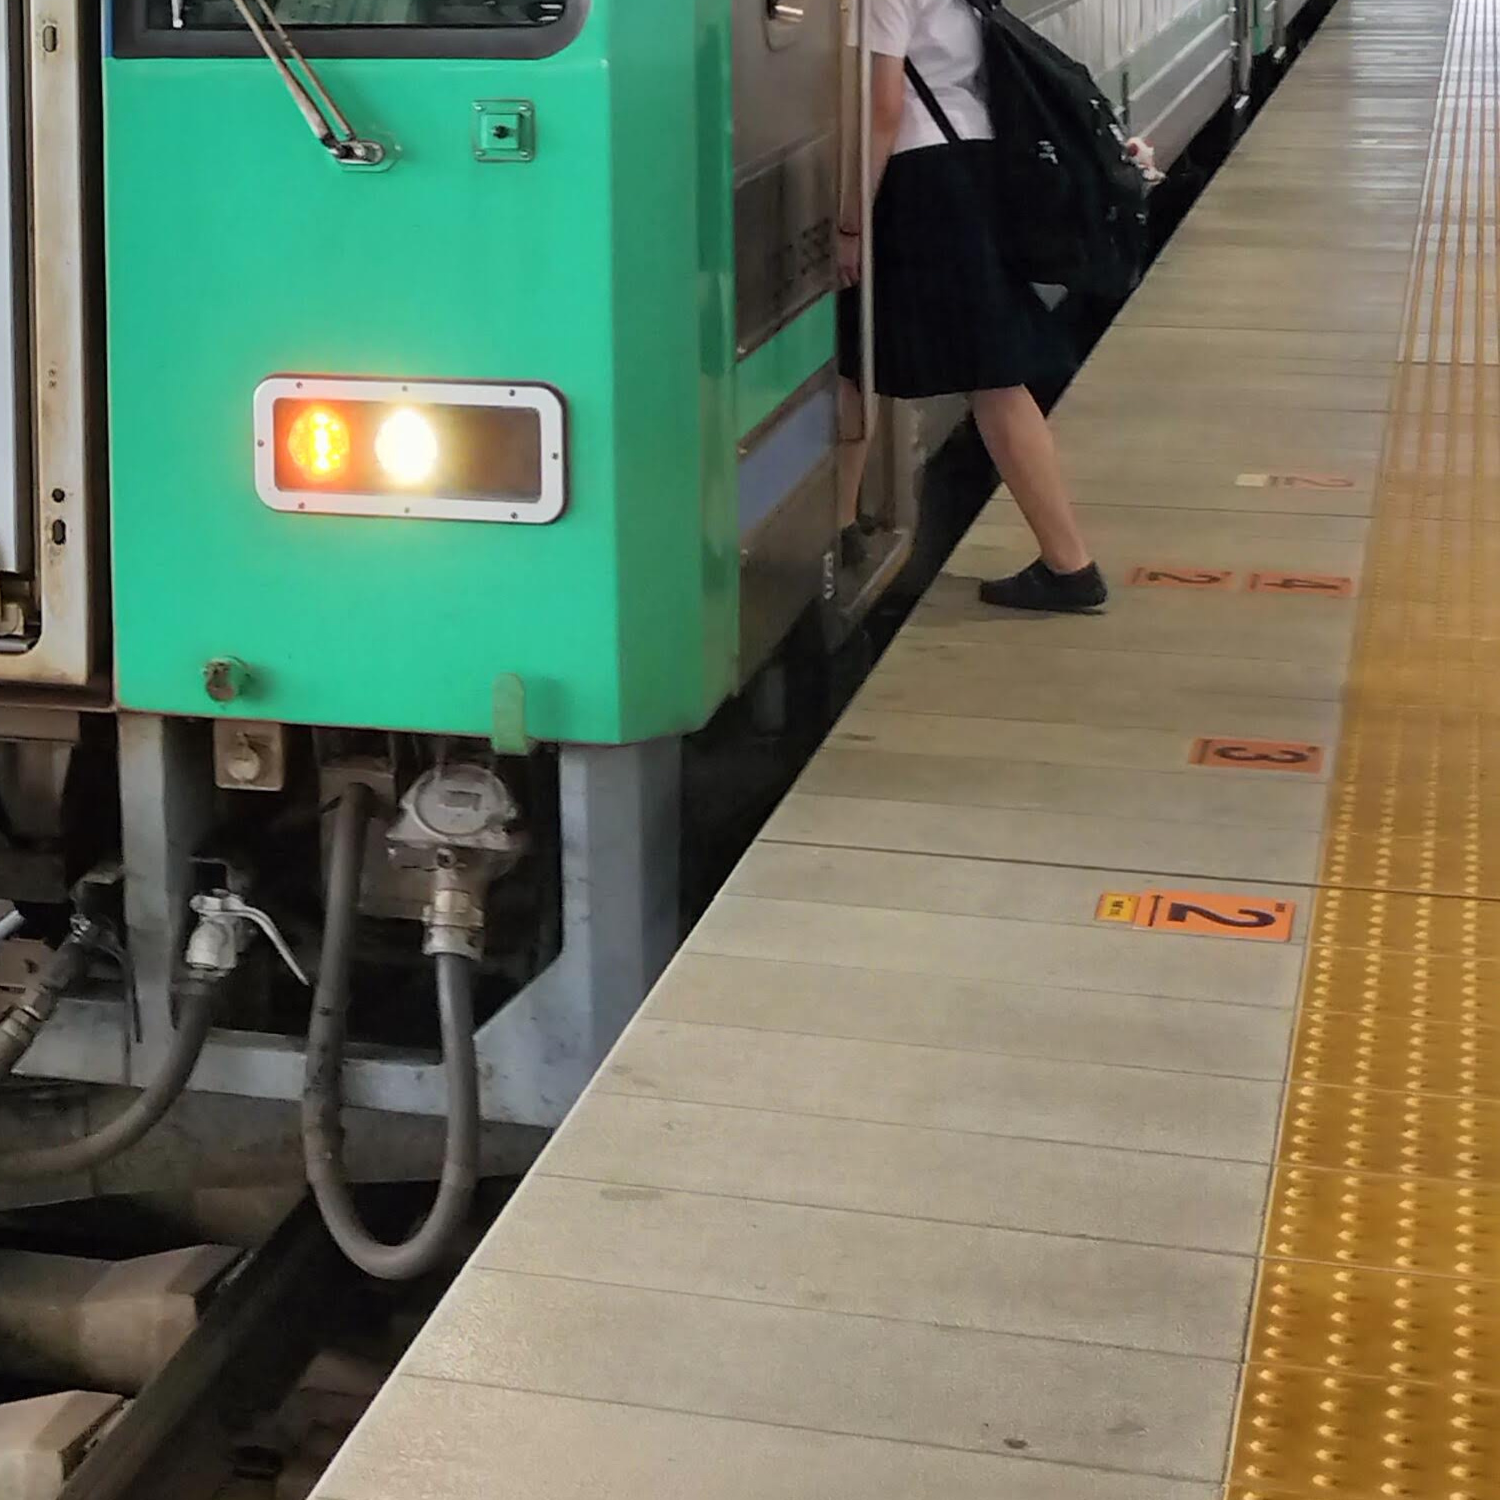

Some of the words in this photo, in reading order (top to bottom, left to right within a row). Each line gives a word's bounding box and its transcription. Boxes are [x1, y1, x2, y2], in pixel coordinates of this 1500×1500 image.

[1145, 571, 1221, 584] 2
[1213, 746, 1311, 764] 3
[1167, 902, 1277, 929] 2
